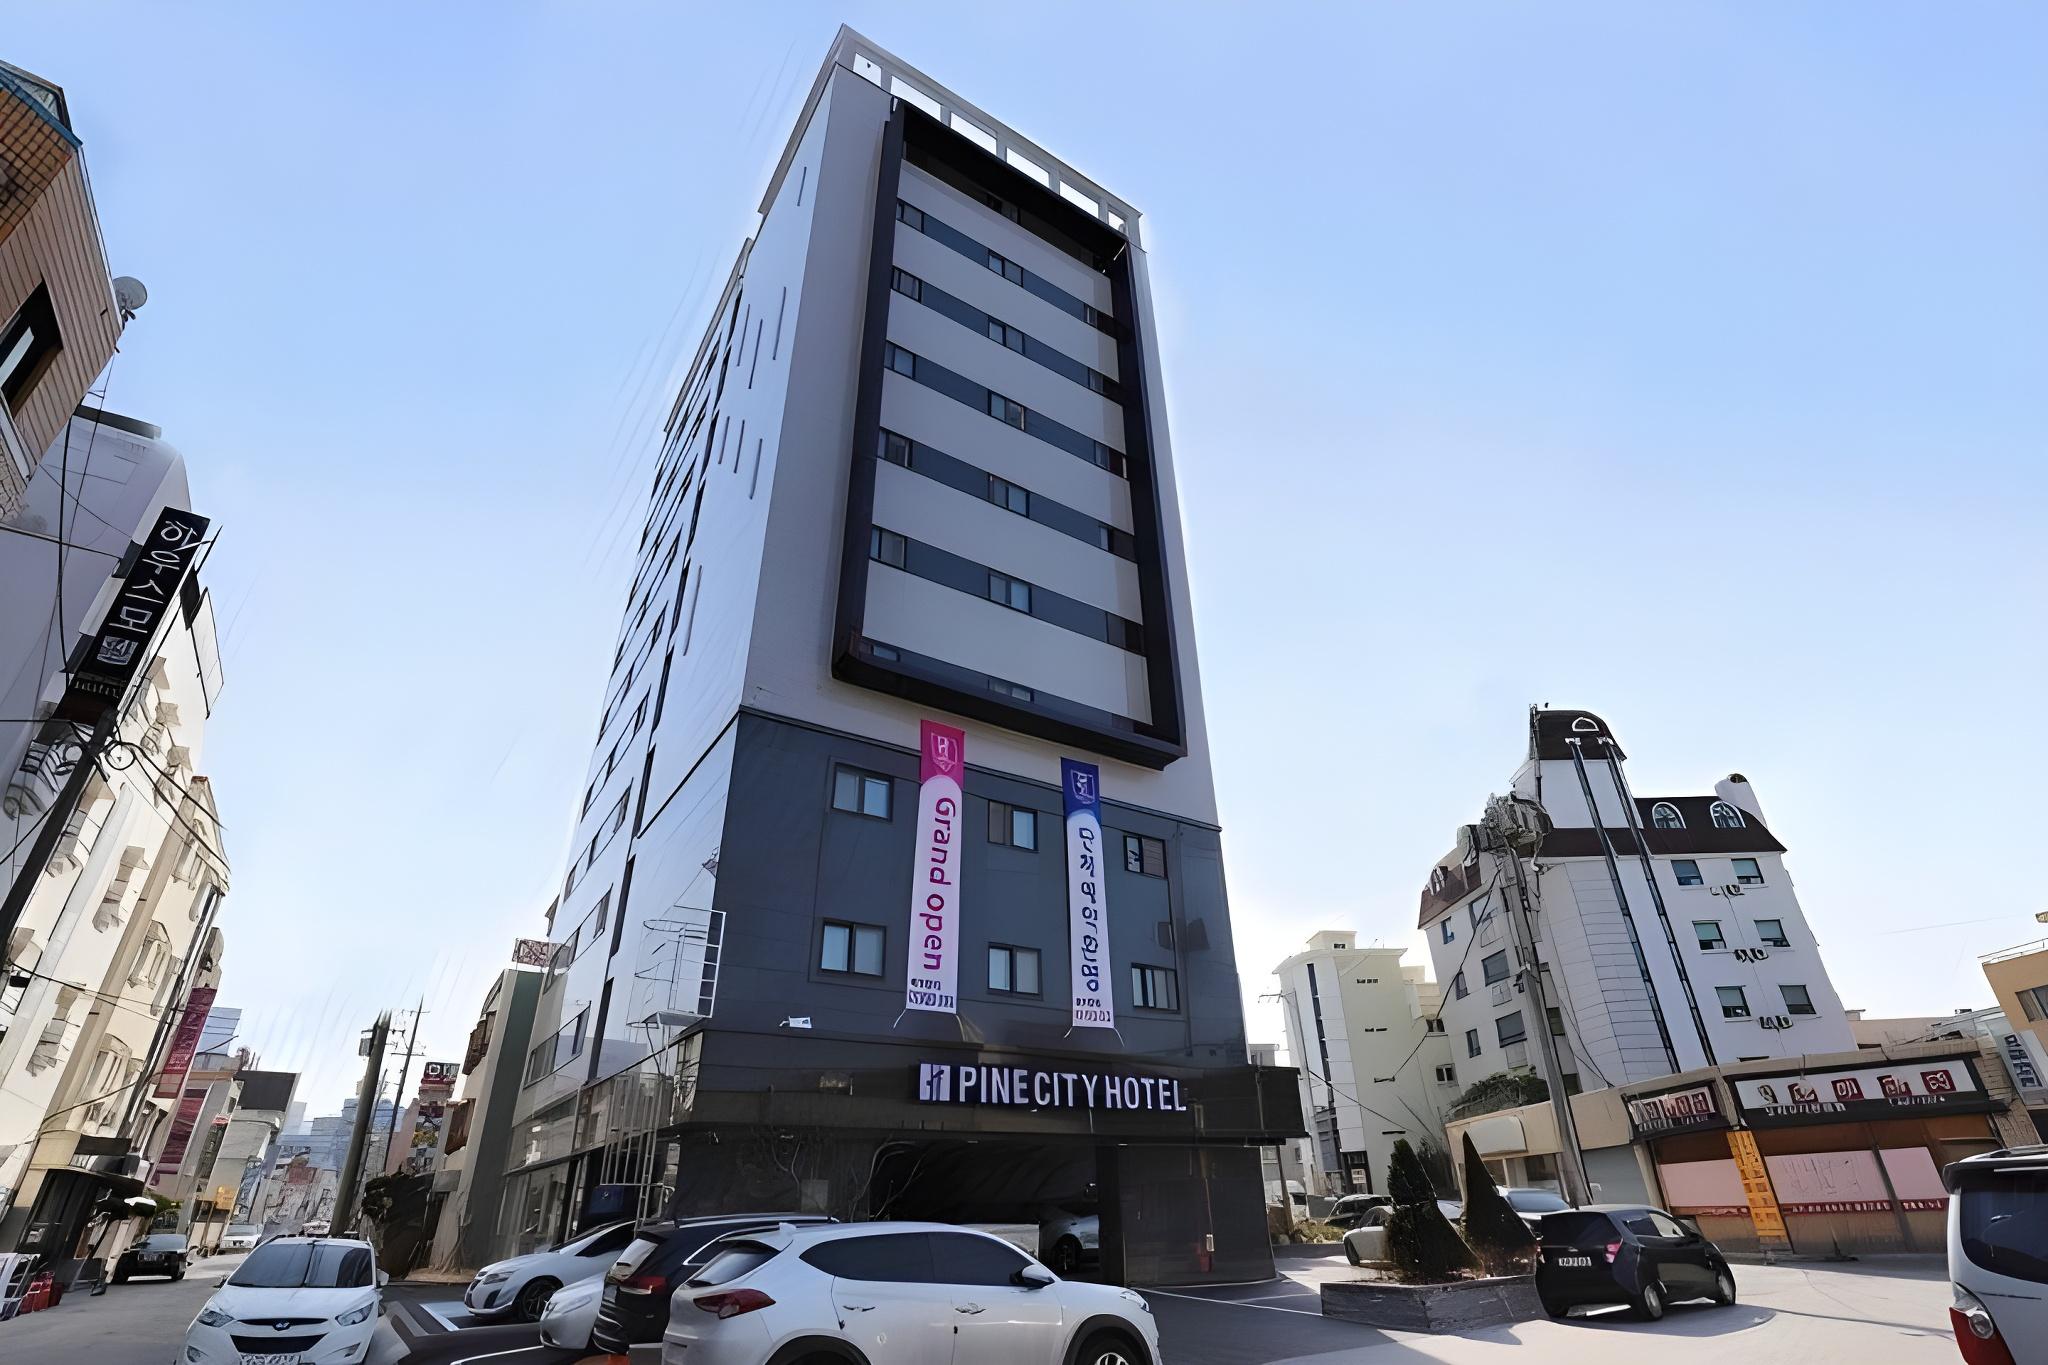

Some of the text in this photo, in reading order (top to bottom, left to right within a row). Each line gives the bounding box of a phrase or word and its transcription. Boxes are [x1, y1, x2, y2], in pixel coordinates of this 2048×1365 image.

[929, 796, 956, 886] Grand
[919, 893, 946, 971] open
[959, 1065, 1187, 1111] PINE CITY HOTEL
